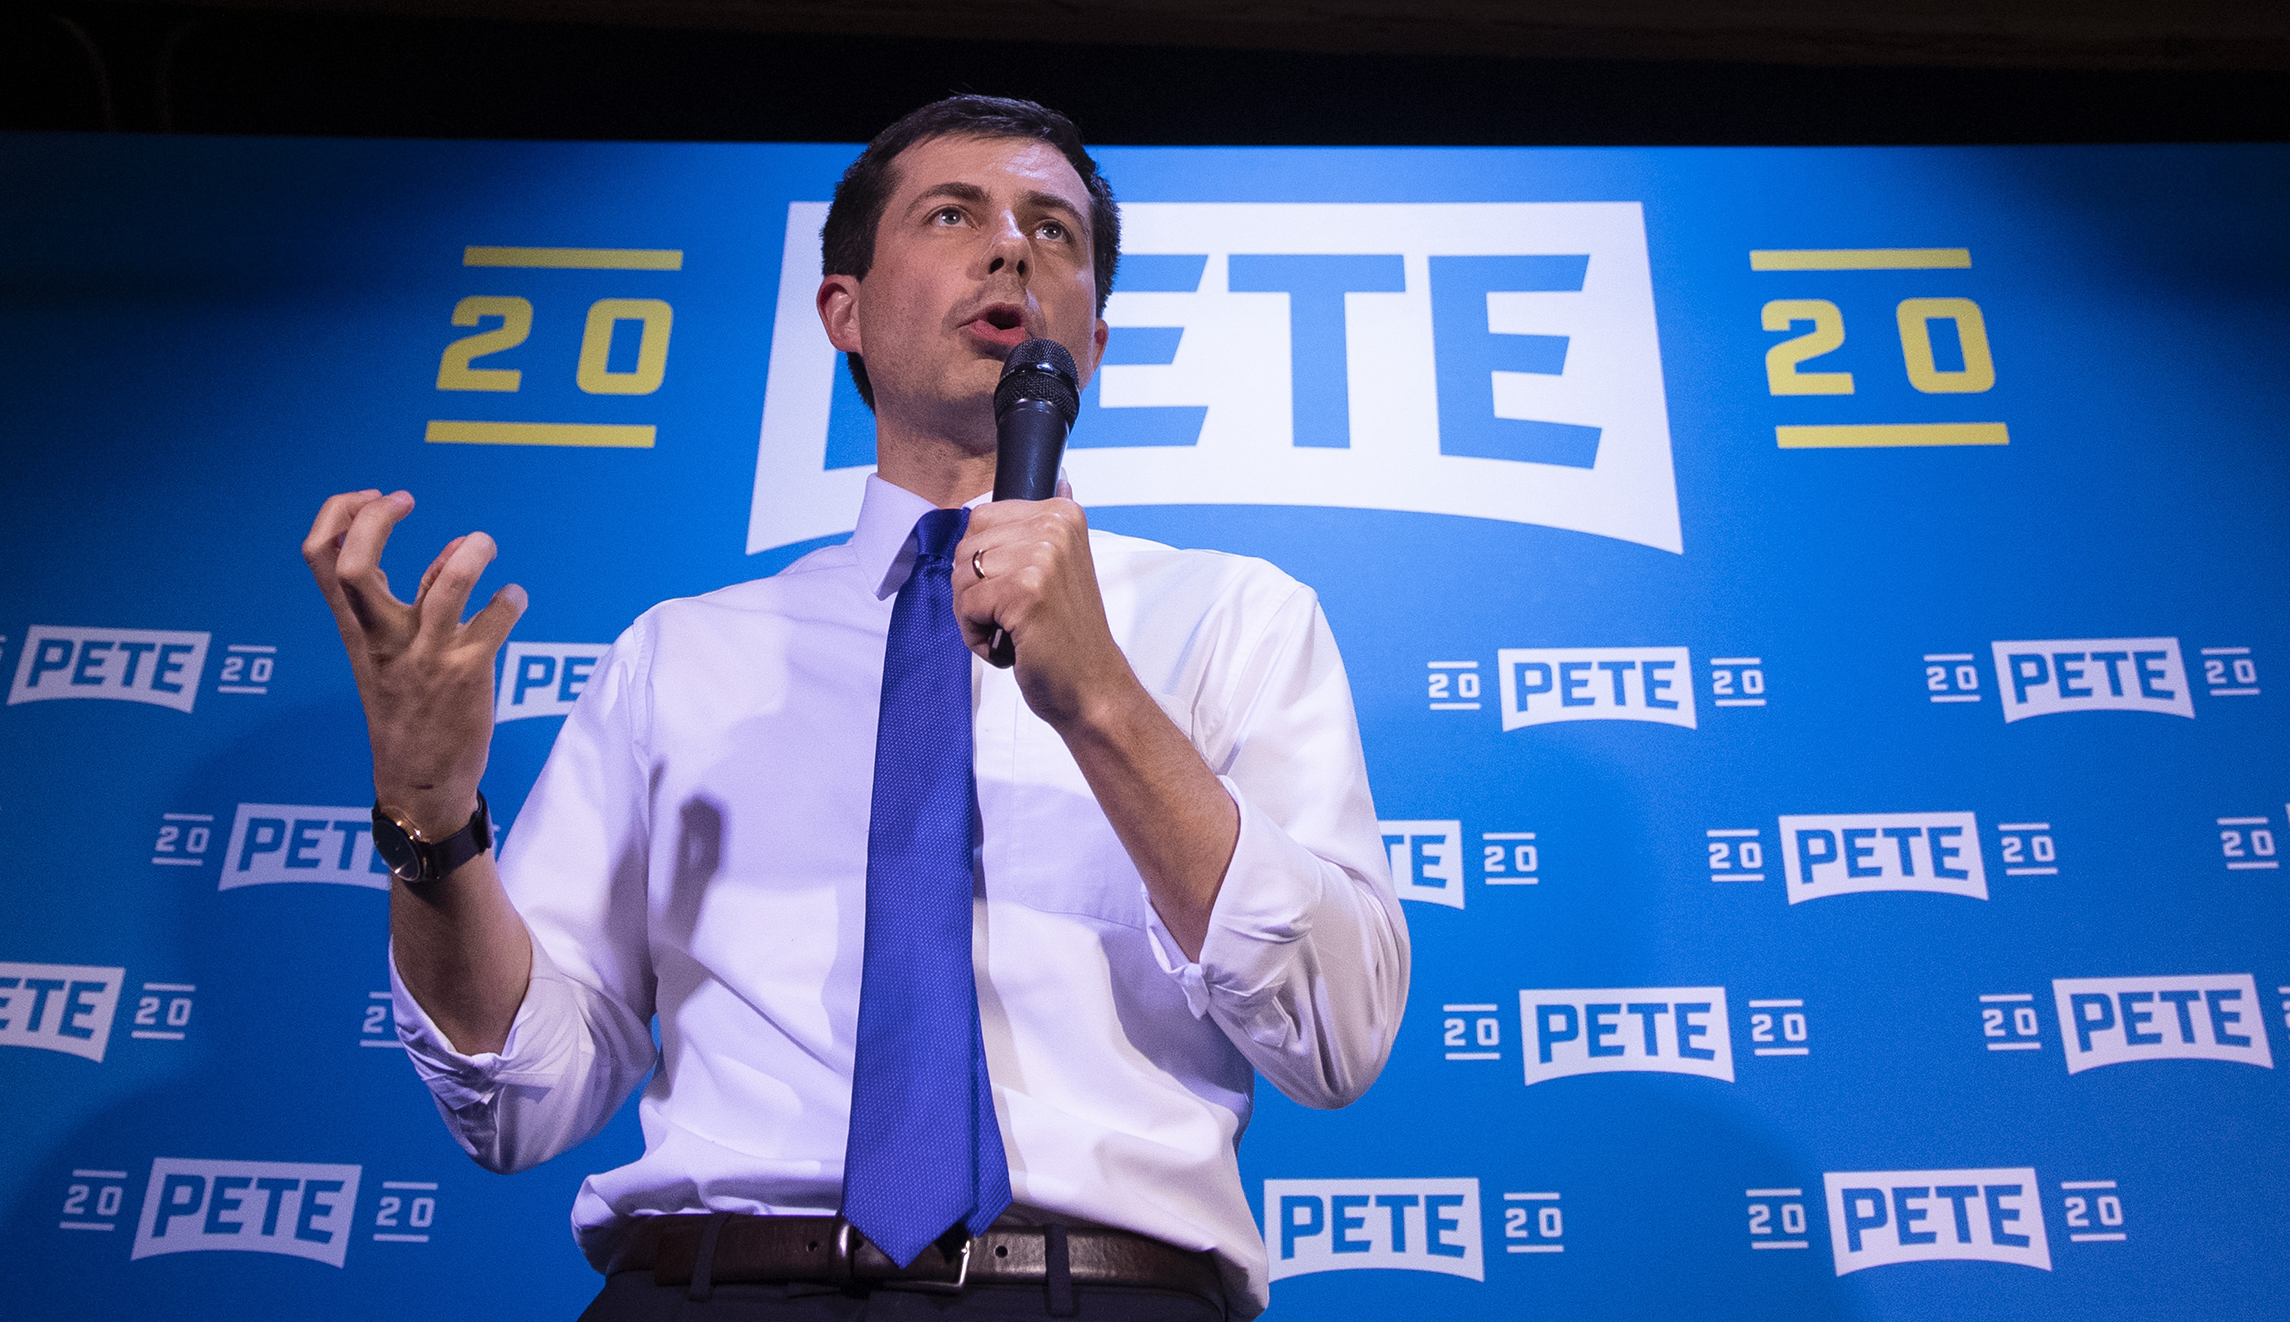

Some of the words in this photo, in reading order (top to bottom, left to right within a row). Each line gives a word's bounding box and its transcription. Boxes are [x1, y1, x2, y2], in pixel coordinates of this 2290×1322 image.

[437, 296, 674, 396] 20
[824, 253, 1603, 471] ETE
[1761, 298, 1996, 396] 20
[26, 638, 194, 694] PETE
[220, 656, 274, 683] 20
[511, 655, 598, 705] PE
[1428, 672, 1481, 699] 20
[1514, 660, 1679, 713] PETE
[1712, 669, 1765, 695] 20
[1925, 665, 1979, 691] 20
[2008, 650, 2175, 704] PETE
[2205, 658, 2257, 685] 20
[154, 825, 211, 854] 20
[238, 817, 388, 874] PET
[1483, 845, 1538, 873] 20
[1708, 841, 1763, 870] 20
[1795, 826, 1969, 884] PETE
[2000, 835, 2056, 863] 20
[2220, 829, 2276, 857] 20
[134, 996, 192, 1027] 20
[362, 1005, 387, 1033] 2
[1443, 1017, 1500, 1047] 20
[1536, 1002, 1715, 1064] PETE
[1750, 1013, 1808, 1043] 20
[1982, 1007, 2039, 1037] 20
[2070, 989, 2251, 1053] PETE
[62, 1184, 123, 1216] 20
[151, 1173, 345, 1244] PETE
[375, 1196, 436, 1228] 20
[1280, 1194, 1466, 1260] PETE
[1504, 1207, 1563, 1238] 20
[1747, 1203, 1807, 1235] 20
[1841, 1184, 2030, 1253] PETE
[2064, 1195, 2124, 1227] 20
